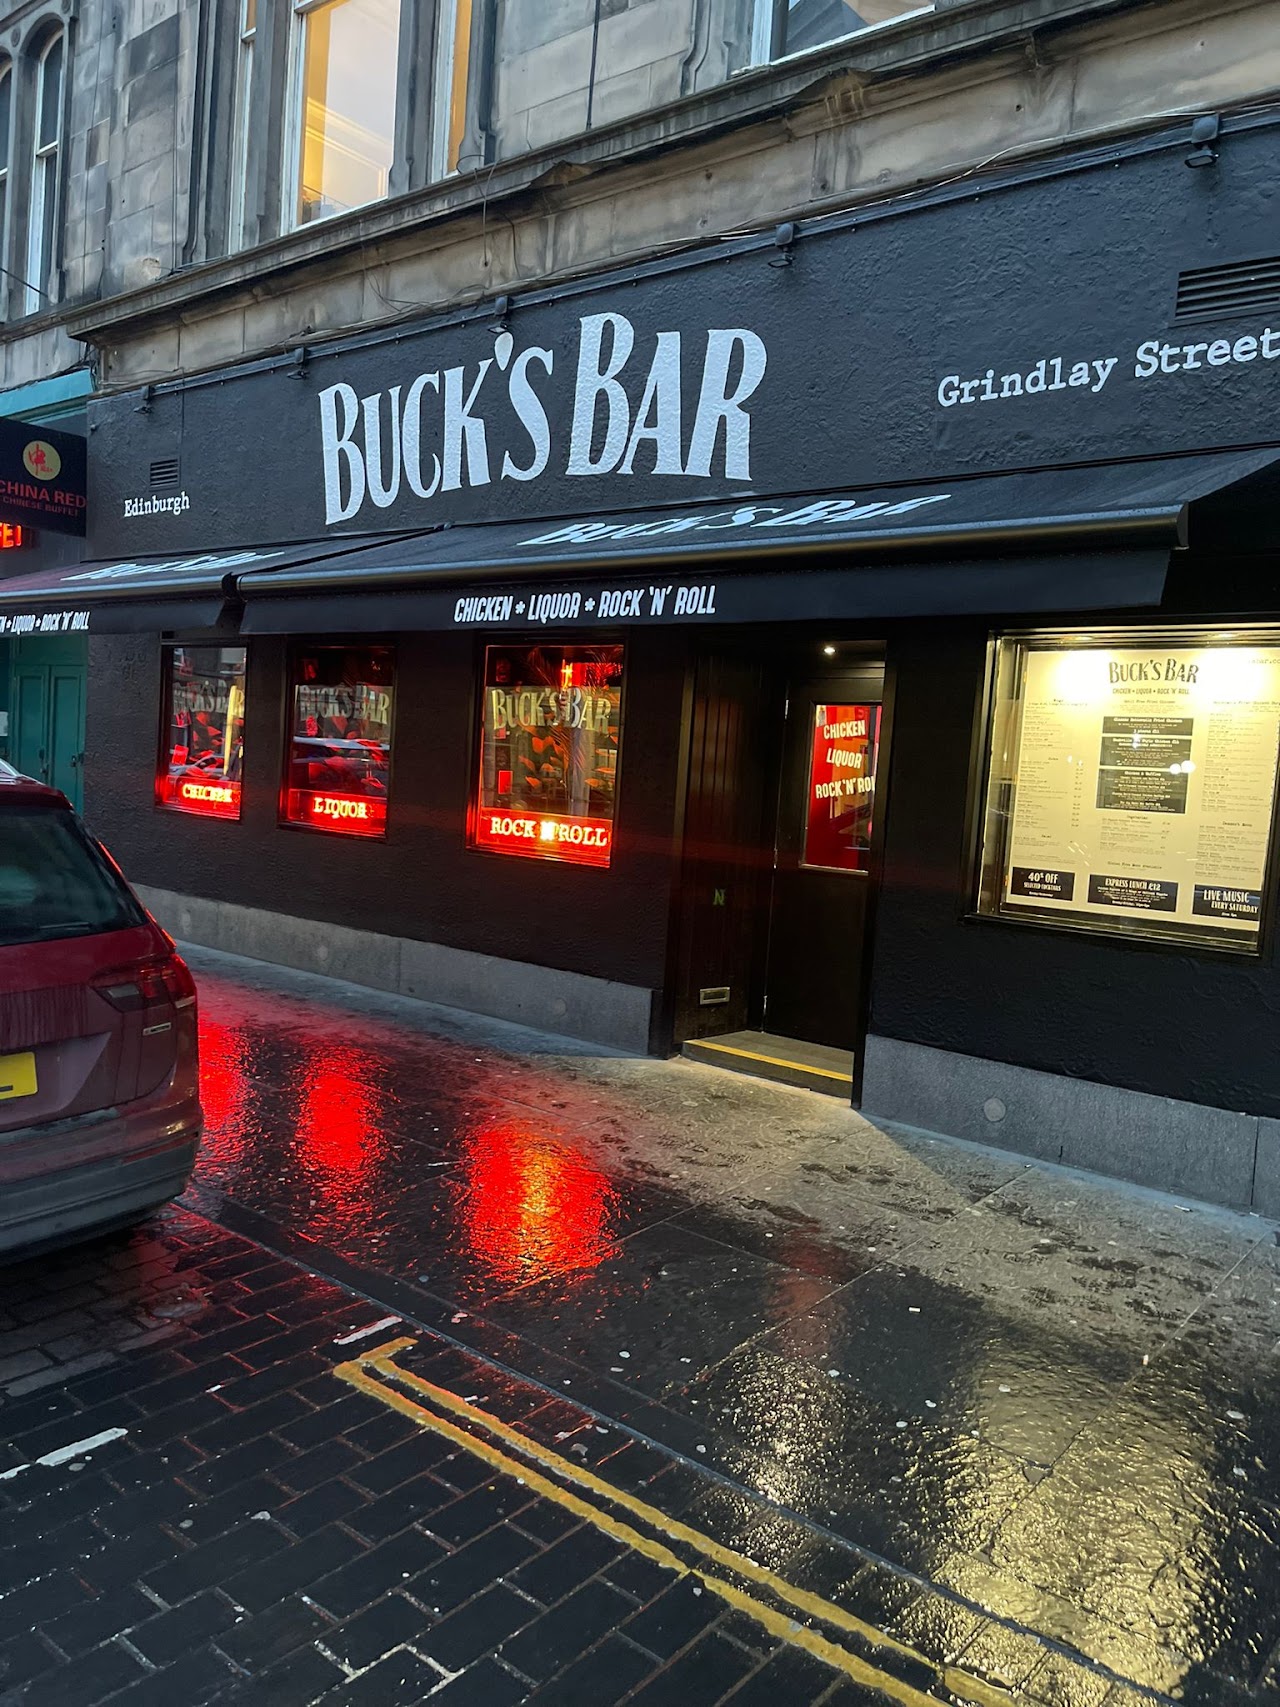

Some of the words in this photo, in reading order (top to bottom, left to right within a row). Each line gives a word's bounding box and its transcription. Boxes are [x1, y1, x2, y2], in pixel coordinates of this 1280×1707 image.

[937, 356, 1118, 407] Grindlay
[1135, 327, 1280, 378] Street
[318, 331, 555, 525] BUCK'S
[565, 312, 767, 481] BAR
[54, 489, 87, 508] RED
[124, 491, 190, 518] Edinburgh
[454, 595, 513, 623] CHICKEN
[528, 592, 581, 624] LIQUOR
[598, 589, 641, 618] ROCK
[673, 585, 716, 615] ROLL
[40, 613, 62, 631] ROCK
[71, 611, 91, 630] ROLL
[1108, 659, 1162, 684] BUCK'S
[1164, 658, 1199, 684] BAR
[564, 687, 612, 734] BAR
[823, 719, 866, 740] CHICKEN
[826, 747, 863, 769] LIQUOR
[490, 816, 537, 838] ROCK
[558, 822, 608, 847] ROLL
[1045, 873, 1059, 884] OFF
[1203, 889, 1221, 901] LIVE
[1222, 890, 1250, 903] MUSIC
[1211, 900, 1229, 910] EVERY
[1228, 902, 1259, 914] SATURDAY
